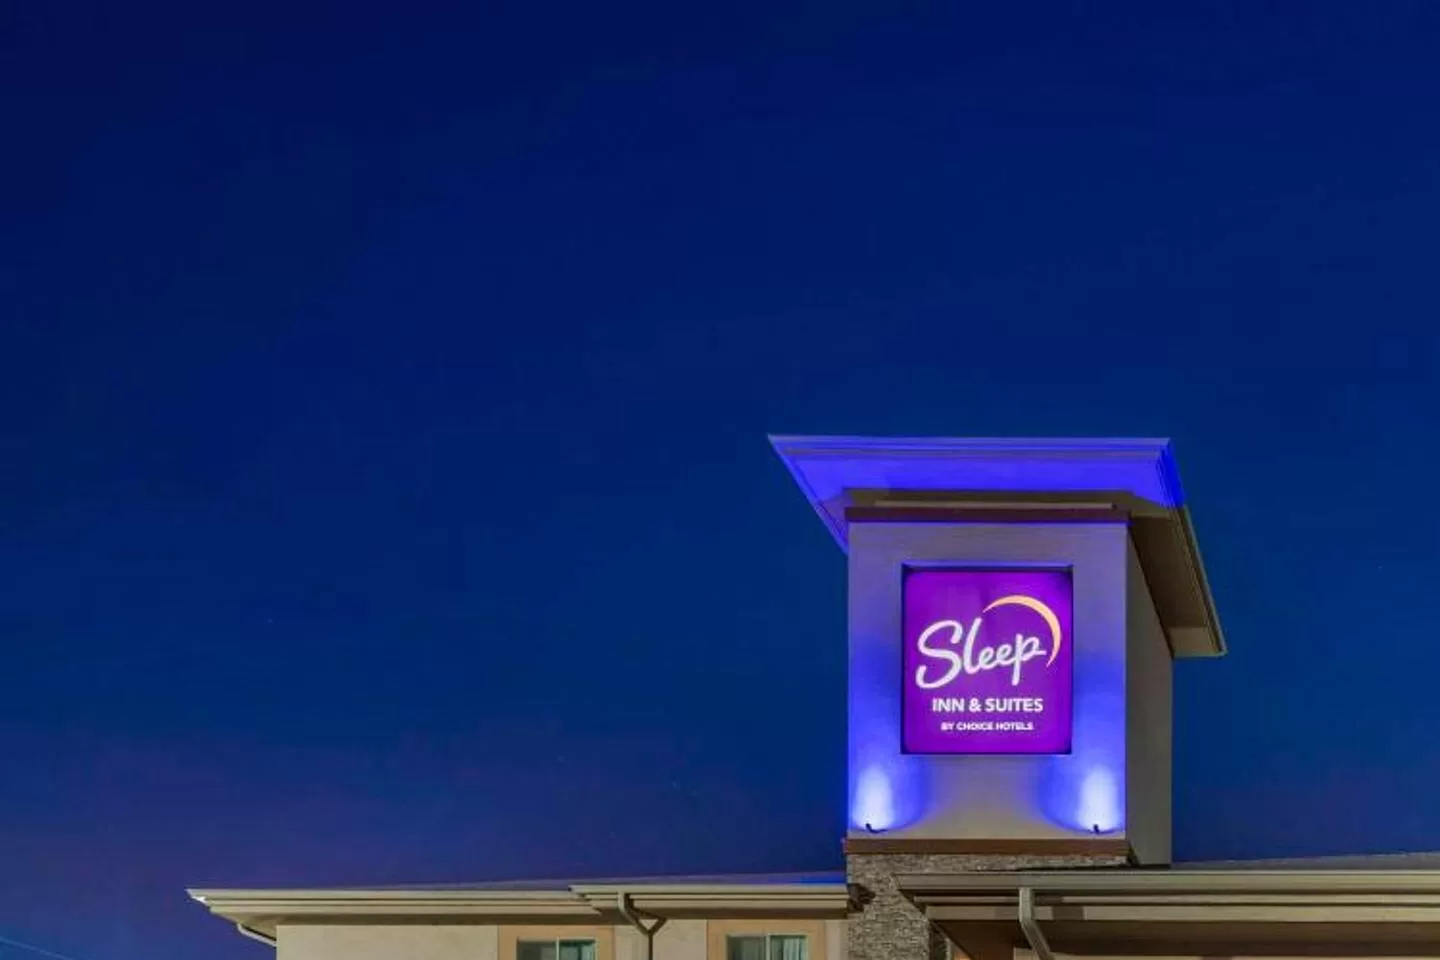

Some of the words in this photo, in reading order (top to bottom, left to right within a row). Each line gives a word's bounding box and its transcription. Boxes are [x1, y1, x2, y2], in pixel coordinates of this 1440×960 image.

[915, 617, 1047, 689] Sleep
[932, 697, 965, 712] INN
[968, 697, 981, 712] &
[984, 697, 1044, 712] SUITES
[941, 722, 953, 731] BY
[956, 722, 993, 731] CHOICE
[996, 722, 1034, 731] HOTELS
